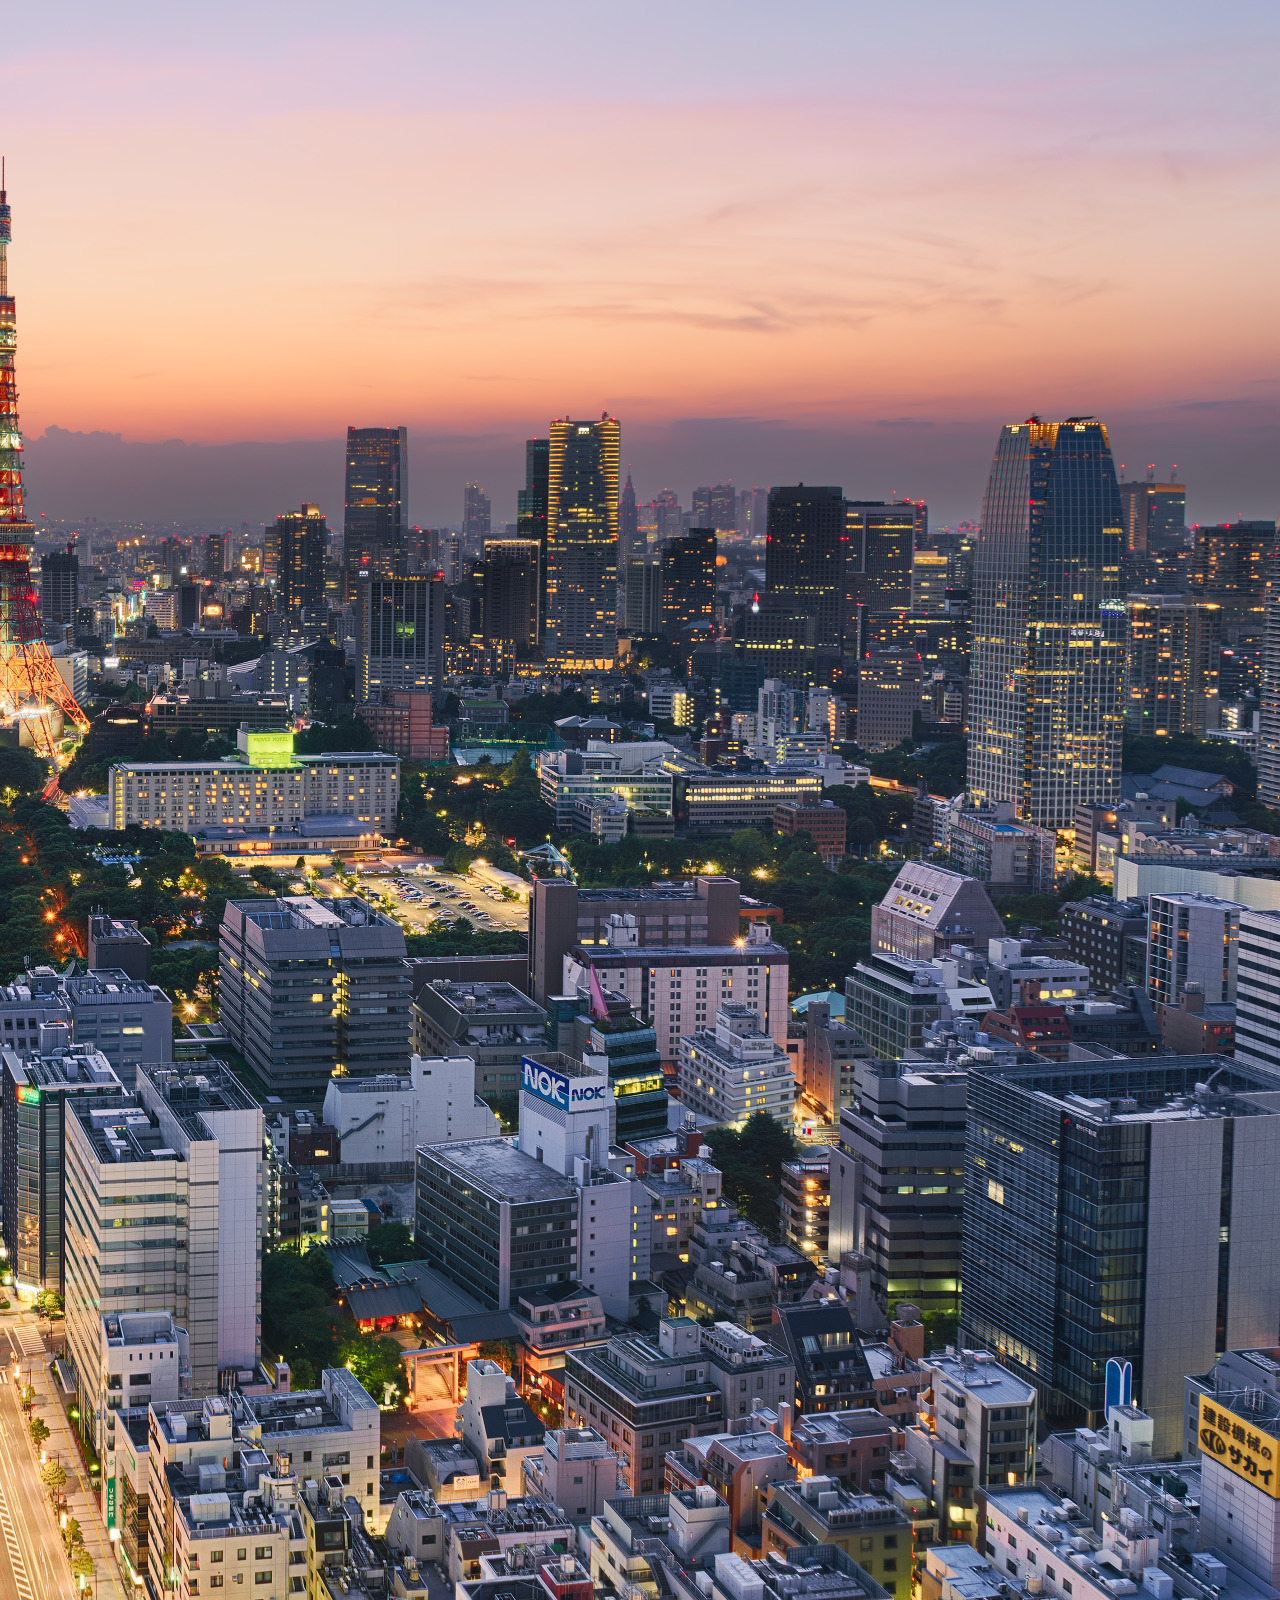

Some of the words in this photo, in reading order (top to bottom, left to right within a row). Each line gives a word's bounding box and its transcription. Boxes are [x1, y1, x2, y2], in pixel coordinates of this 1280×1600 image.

[524, 1063, 566, 1105] NOK
[571, 1085, 606, 1102] NOK
[1202, 1404, 1272, 1461] 建設機械の
[1228, 1444, 1274, 1487] サカイ
